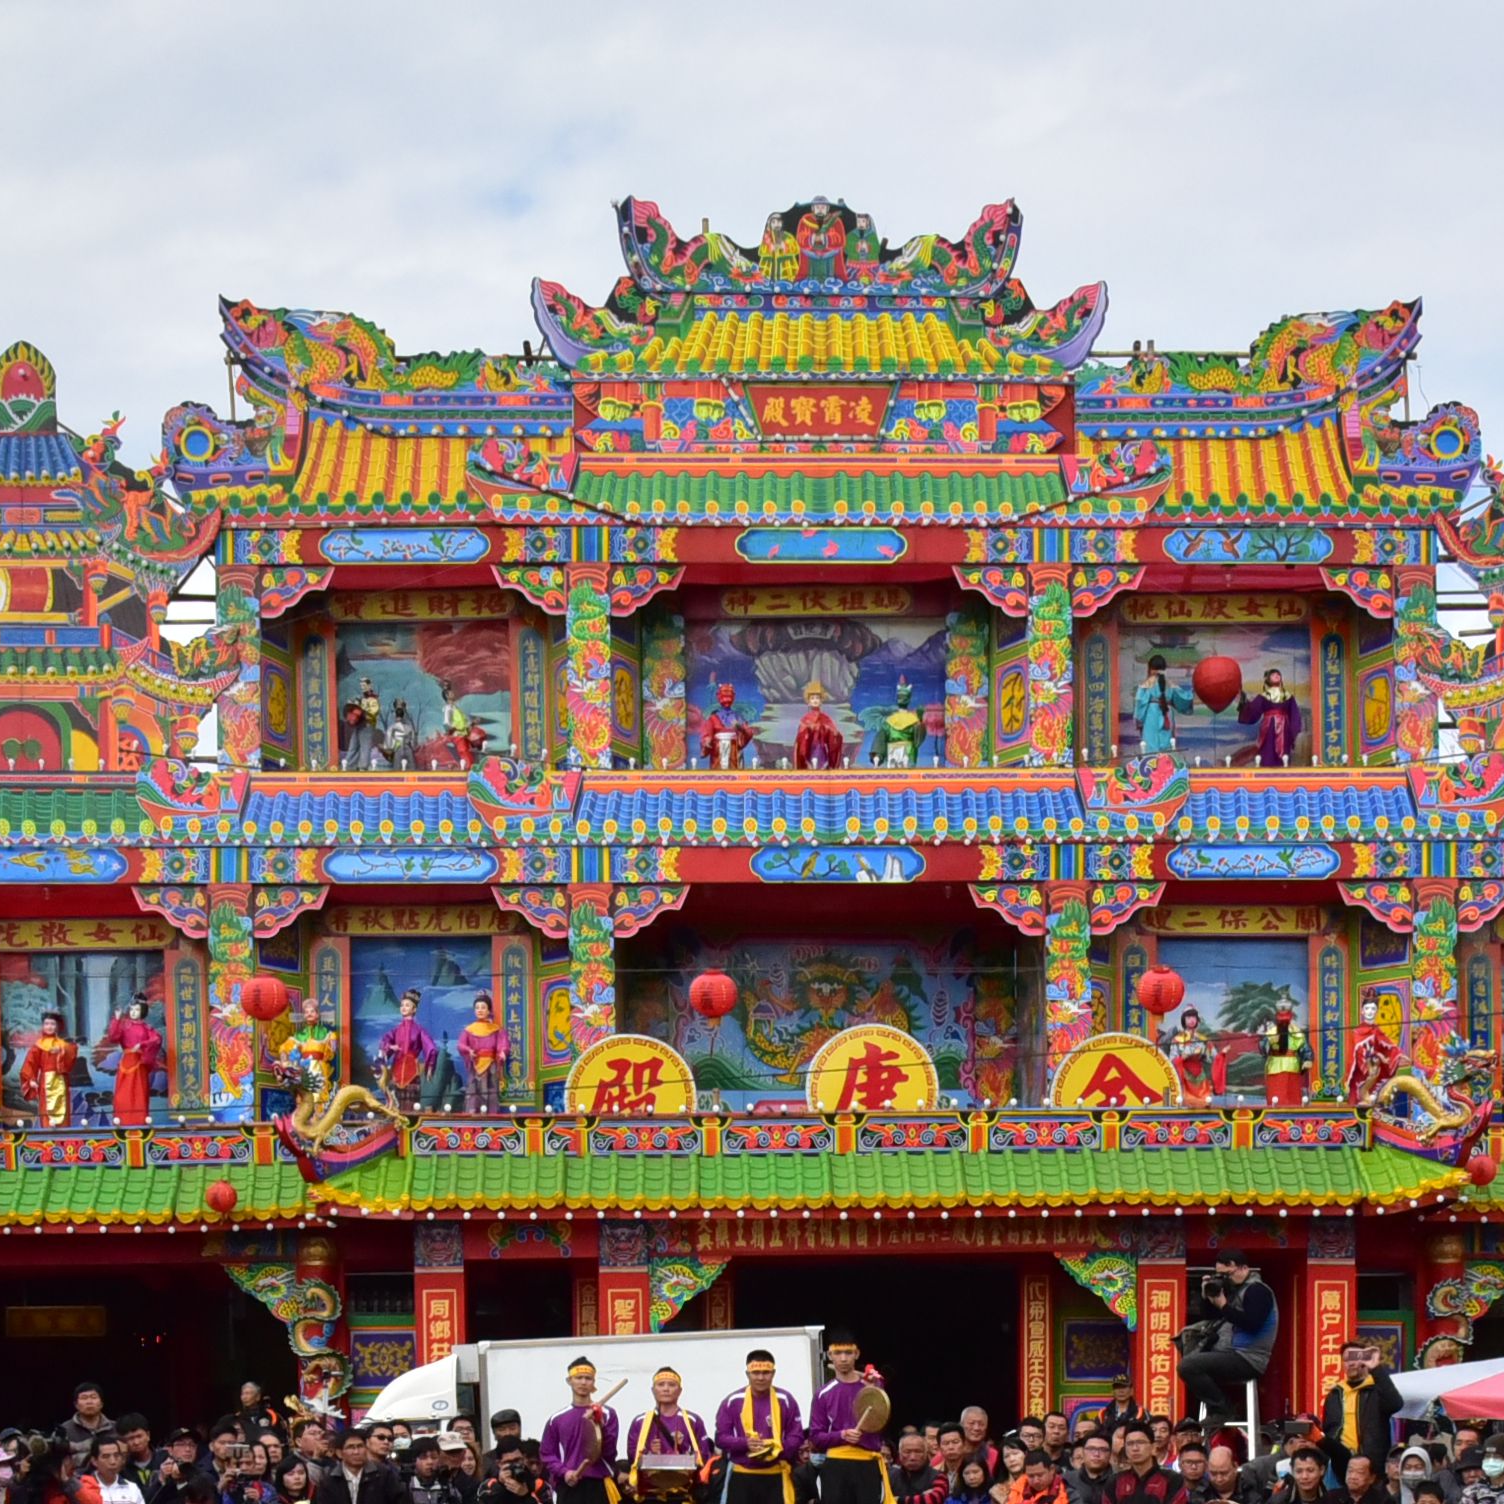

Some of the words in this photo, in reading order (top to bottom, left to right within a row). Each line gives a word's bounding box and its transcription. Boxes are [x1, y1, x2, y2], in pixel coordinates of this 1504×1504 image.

[762, 395, 877, 428] 凌霄寶殿
[333, 591, 508, 619] 招財進寶
[330, 907, 511, 932] 唐伯虎點秋香
[1145, 907, 1322, 932] 關公保二嫂
[1320, 1290, 1343, 1404] 萬戶千門各
